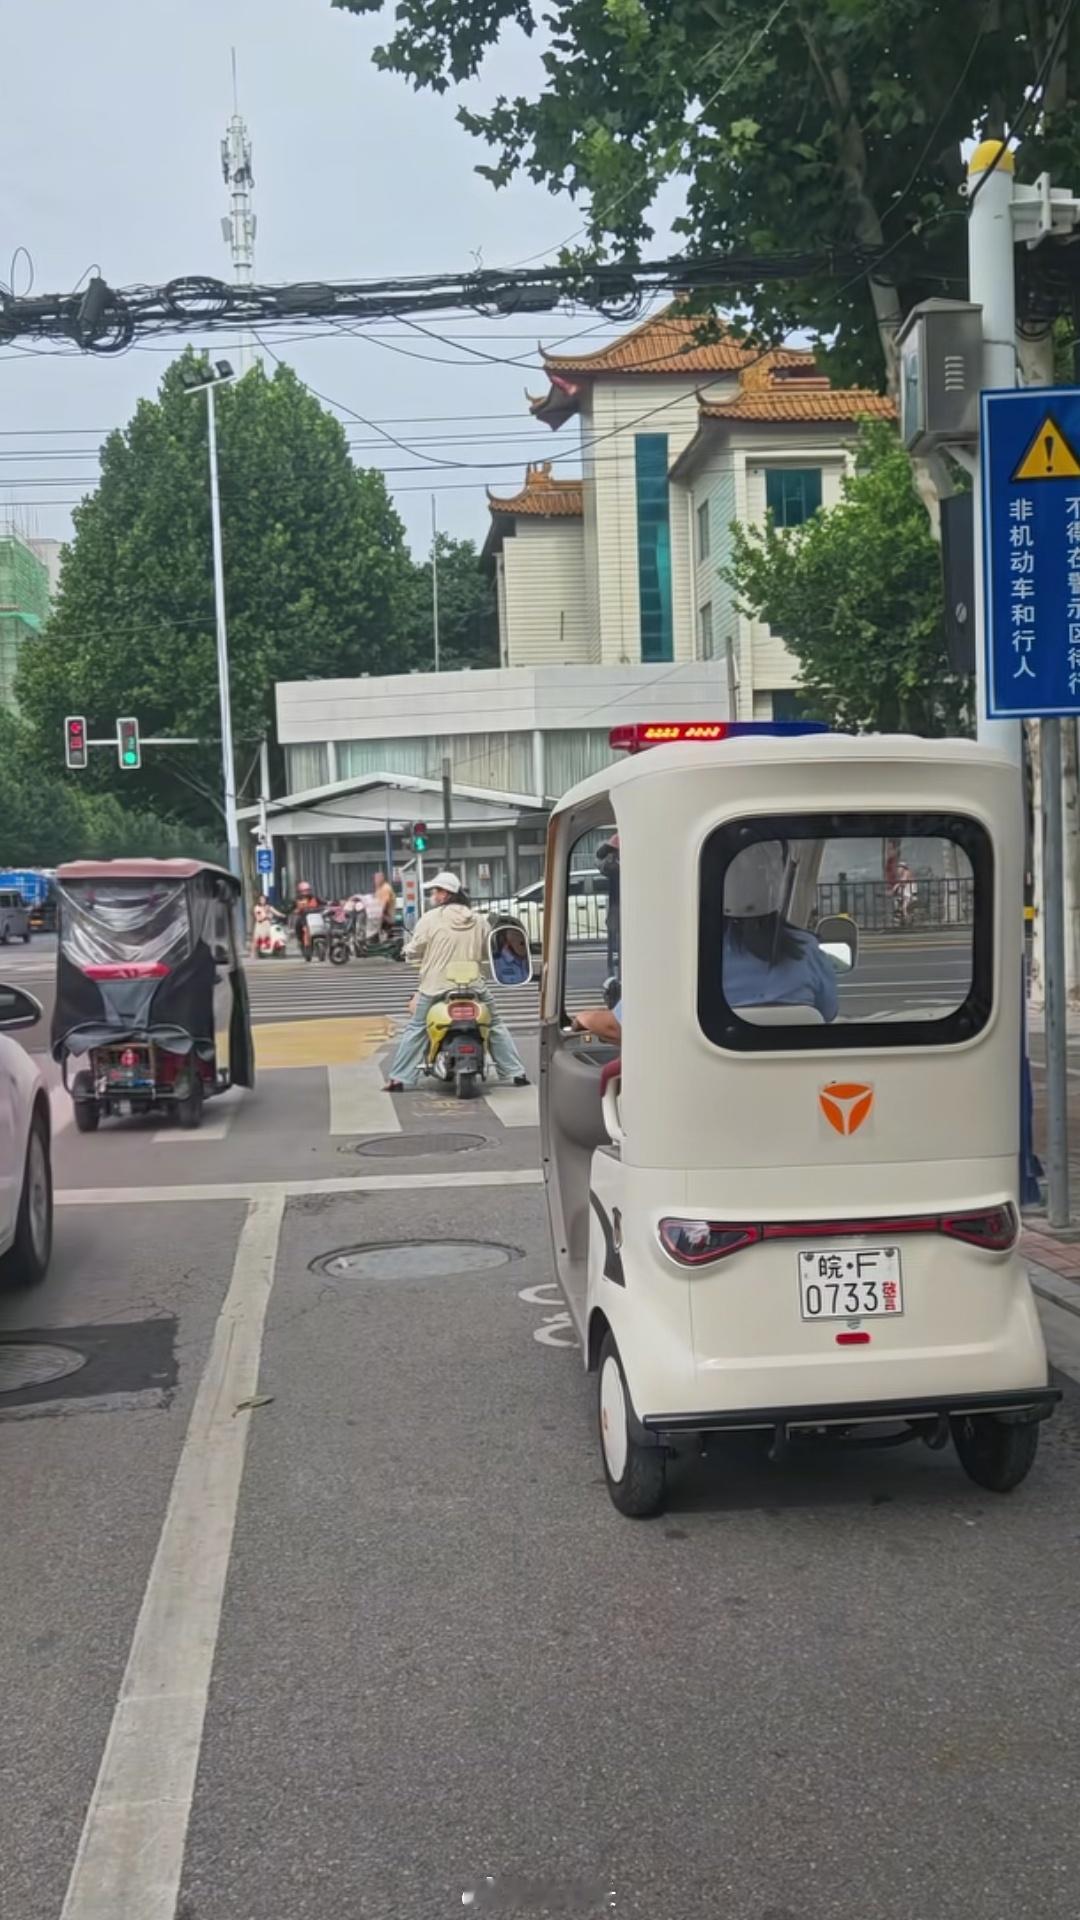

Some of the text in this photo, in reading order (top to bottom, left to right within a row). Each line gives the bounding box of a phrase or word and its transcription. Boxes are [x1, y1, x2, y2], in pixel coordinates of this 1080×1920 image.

[1009, 498, 1036, 678] 非机动车和行人
[806, 1281, 878, 1314] 0733
